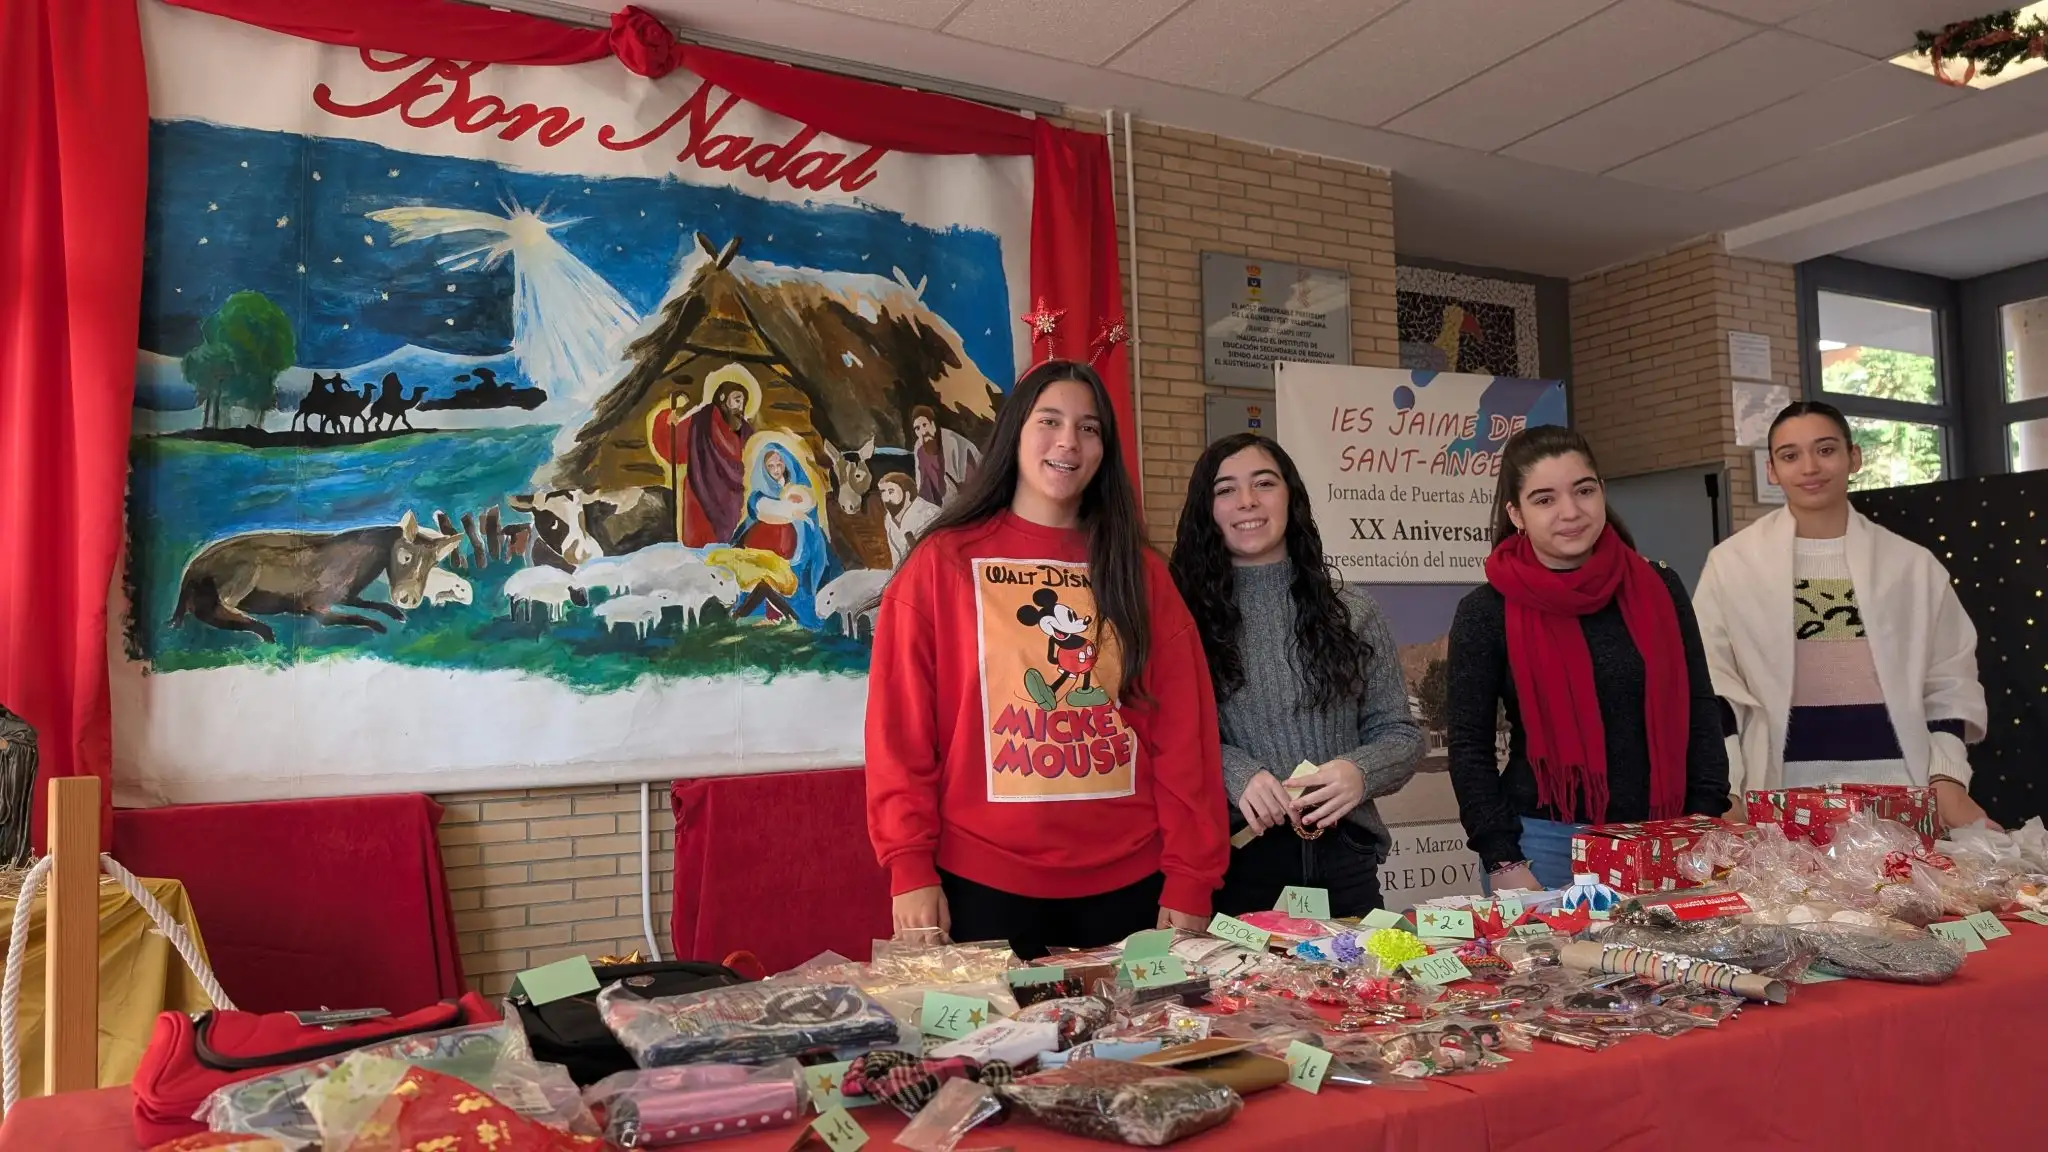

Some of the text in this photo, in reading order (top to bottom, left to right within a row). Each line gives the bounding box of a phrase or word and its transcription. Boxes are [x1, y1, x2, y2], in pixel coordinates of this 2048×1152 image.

[313, 48, 889, 193] Bon Nadal
[1331, 407, 1527, 439] IES JAIME DE
[1340, 446, 1504, 478] SANT-ÁNGE
[1328, 483, 1498, 504] Jornada de Puertas Abi
[1350, 518, 1495, 543] XX Aniversar
[1424, 551, 1445, 568] del
[985, 565, 1093, 588] WALT DISN
[993, 702, 1128, 744] MICKE
[993, 734, 1131, 779] MOUSE
[1386, 839, 1401, 857] 4
[1416, 837, 1463, 854] Marzo
[1384, 862, 1477, 891] REDOV
[1296, 895, 1313, 913] 1€
[1150, 959, 1168, 976] 2€
[1424, 956, 1463, 981] 0,50€
[934, 1005, 961, 1031] 2€
[1297, 1056, 1318, 1079] 1€
